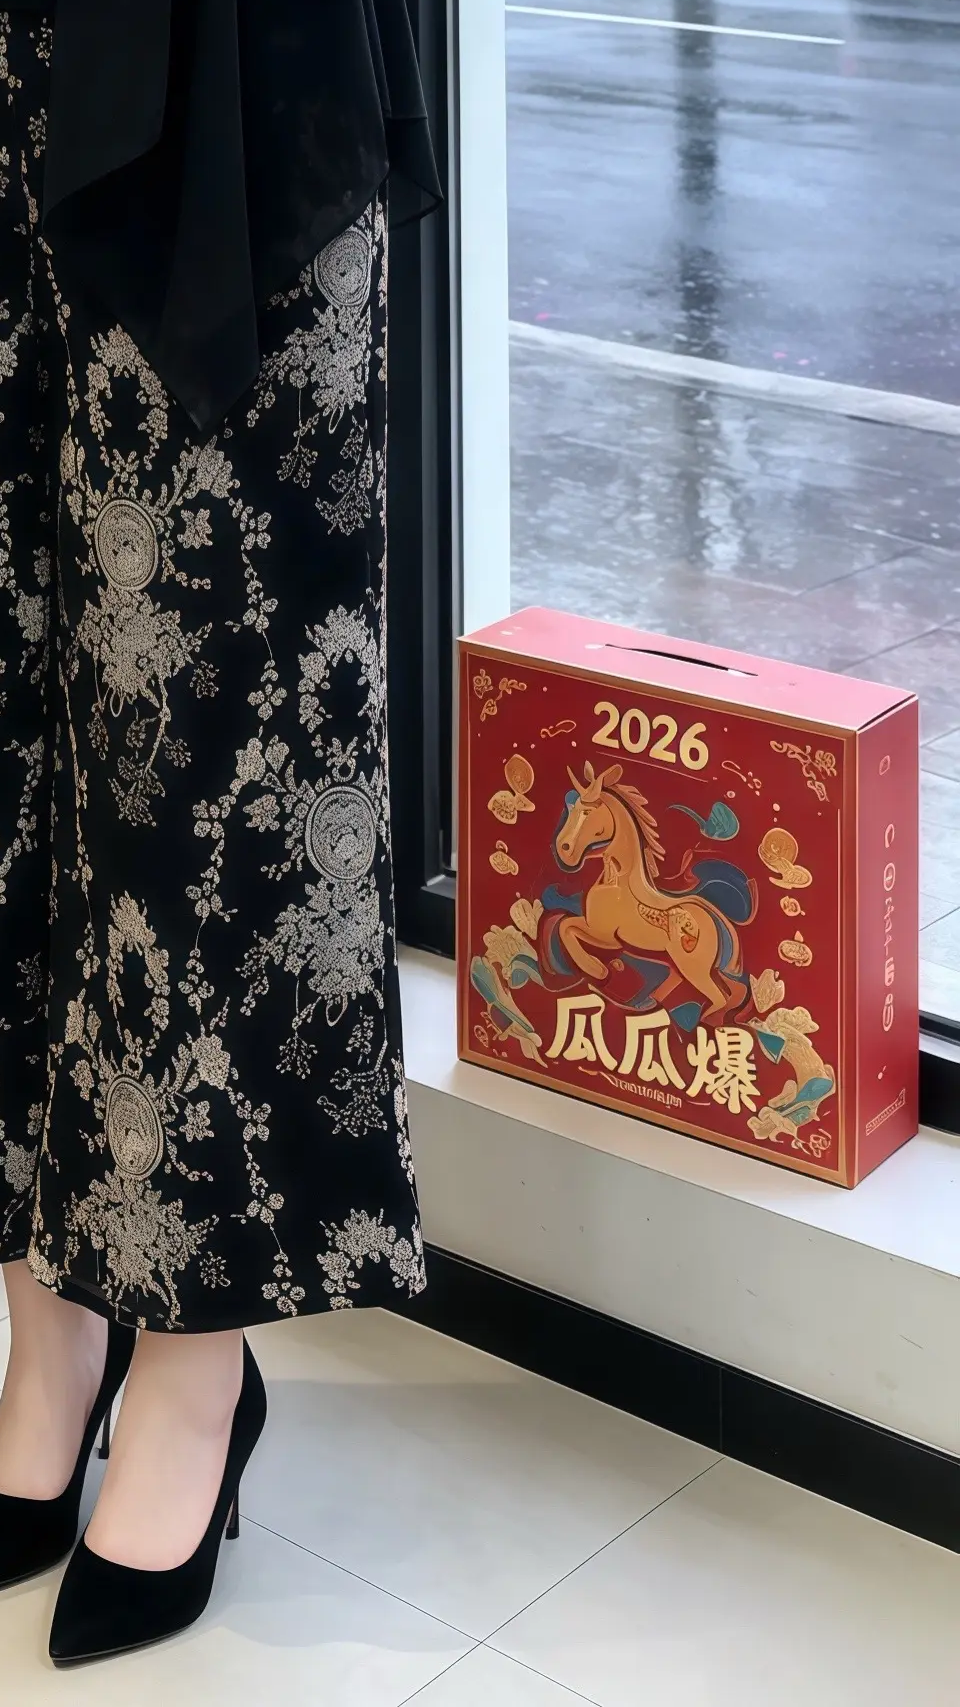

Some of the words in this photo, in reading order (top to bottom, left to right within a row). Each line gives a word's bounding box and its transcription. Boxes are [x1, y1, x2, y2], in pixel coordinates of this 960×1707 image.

[592, 701, 709, 771] 2026
[545, 994, 761, 1114] 瓜瓜爆
